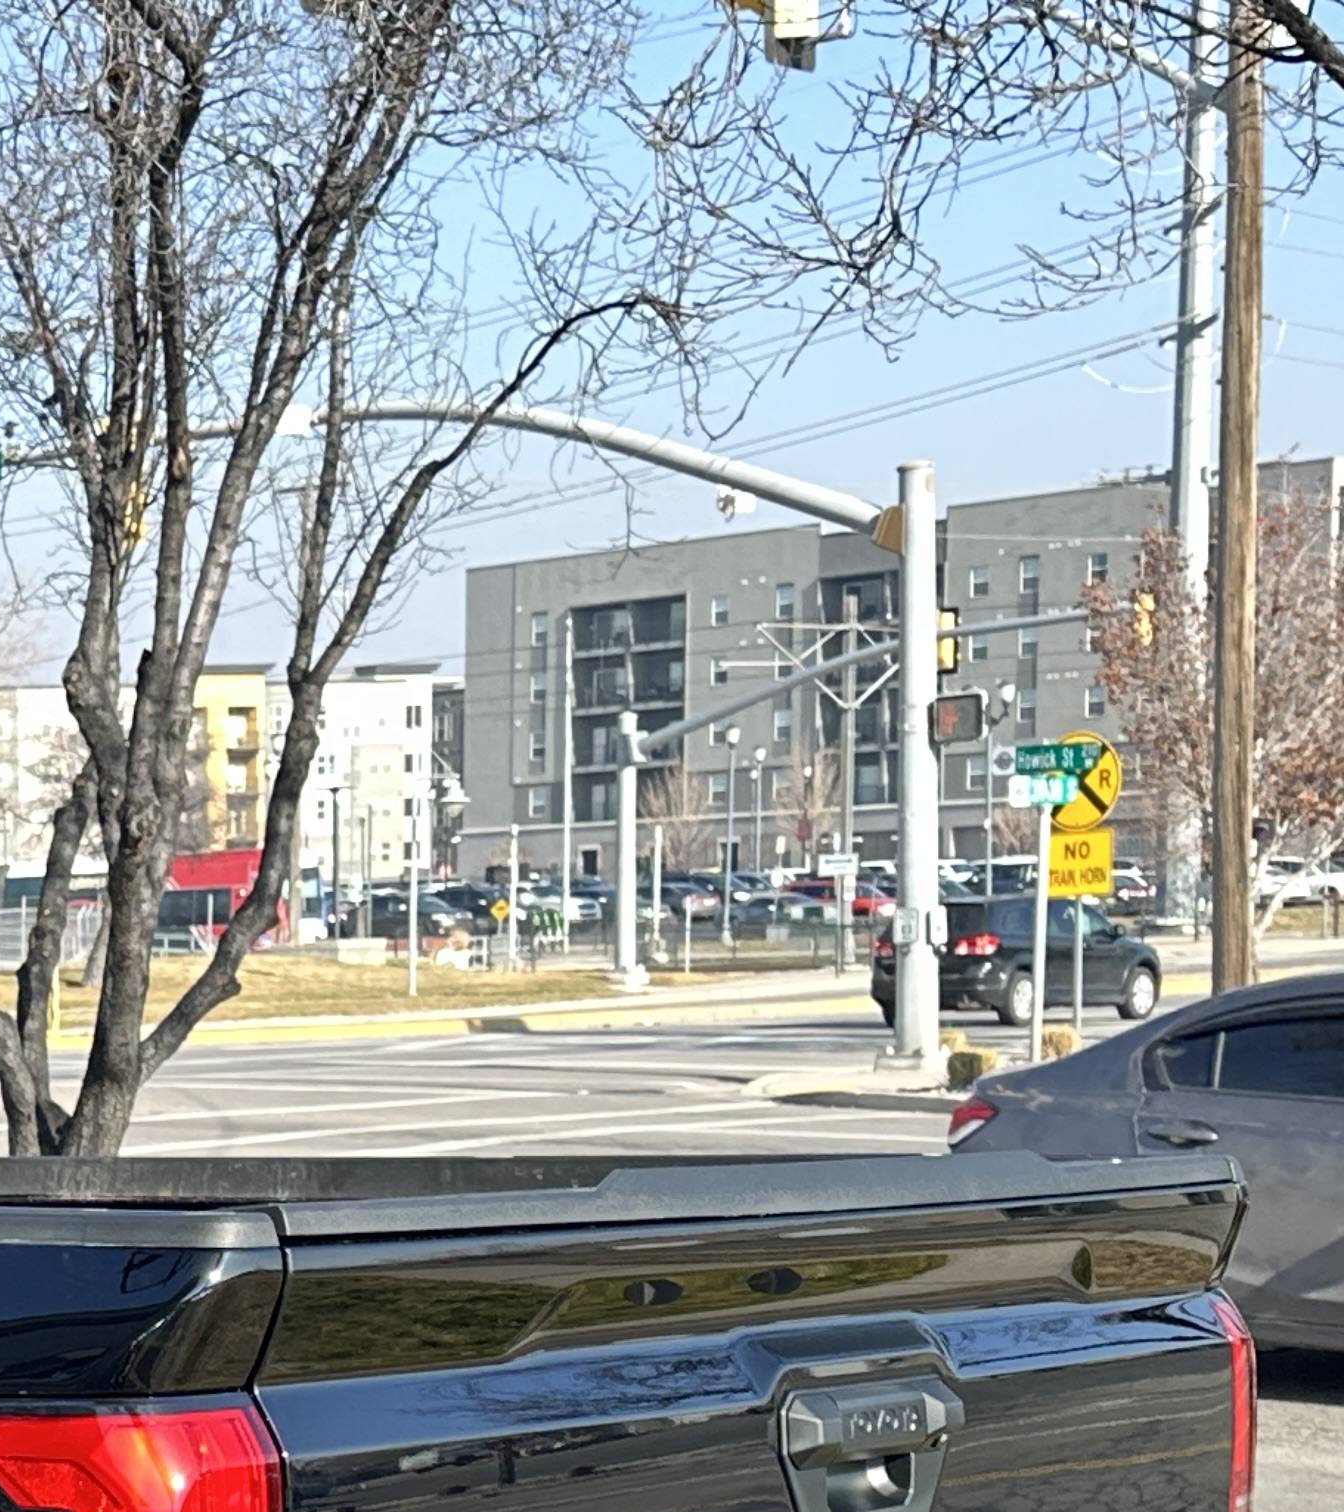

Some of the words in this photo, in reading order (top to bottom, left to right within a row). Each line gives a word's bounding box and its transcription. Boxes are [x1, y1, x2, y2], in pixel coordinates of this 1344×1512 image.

[1061, 747, 1075, 768] St
[1098, 768, 1112, 790] R
[1063, 841, 1091, 860] NO
[1049, 868, 1077, 888] TRAIN
[1079, 866, 1107, 885] HORN
